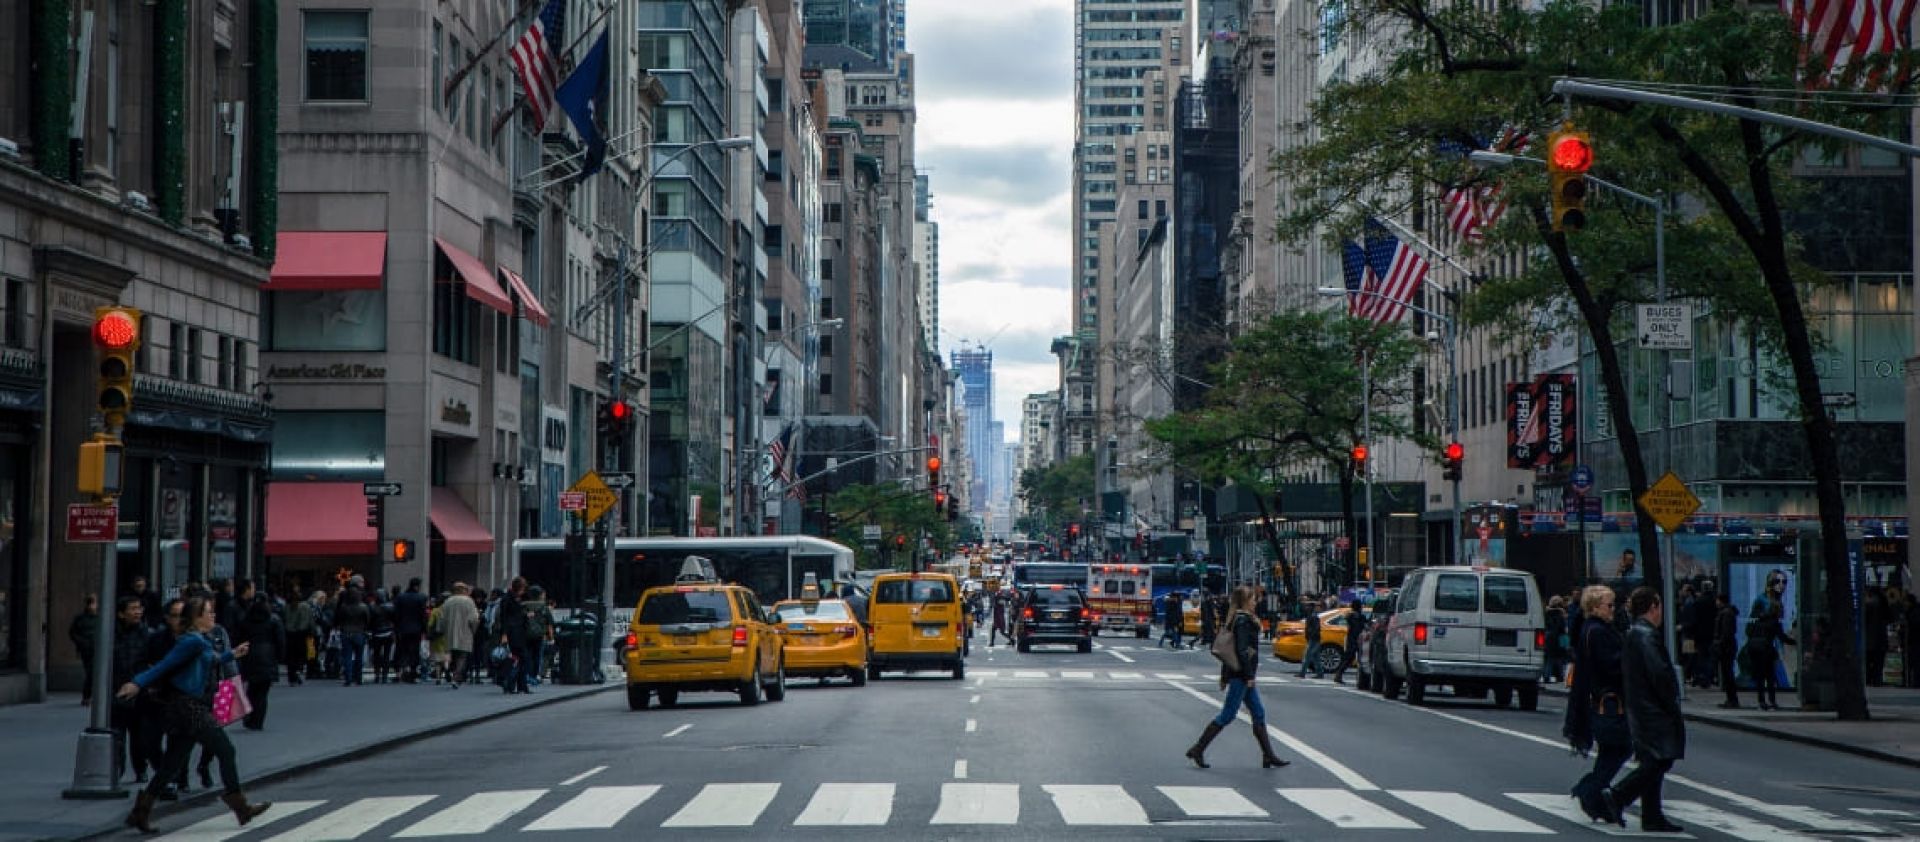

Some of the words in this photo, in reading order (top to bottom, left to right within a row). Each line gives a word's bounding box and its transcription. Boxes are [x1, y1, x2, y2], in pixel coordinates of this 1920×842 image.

[1646, 307, 1682, 317] BUSES
[1651, 323, 1678, 333] ONLY
[266, 363, 328, 378] American
[329, 363, 351, 378] Girl
[353, 363, 386, 378] Place
[1549, 391, 1562, 454] FRIDAYS
[1516, 400, 1530, 459] FRIDYS
[76, 517, 109, 527] ANYTIME
